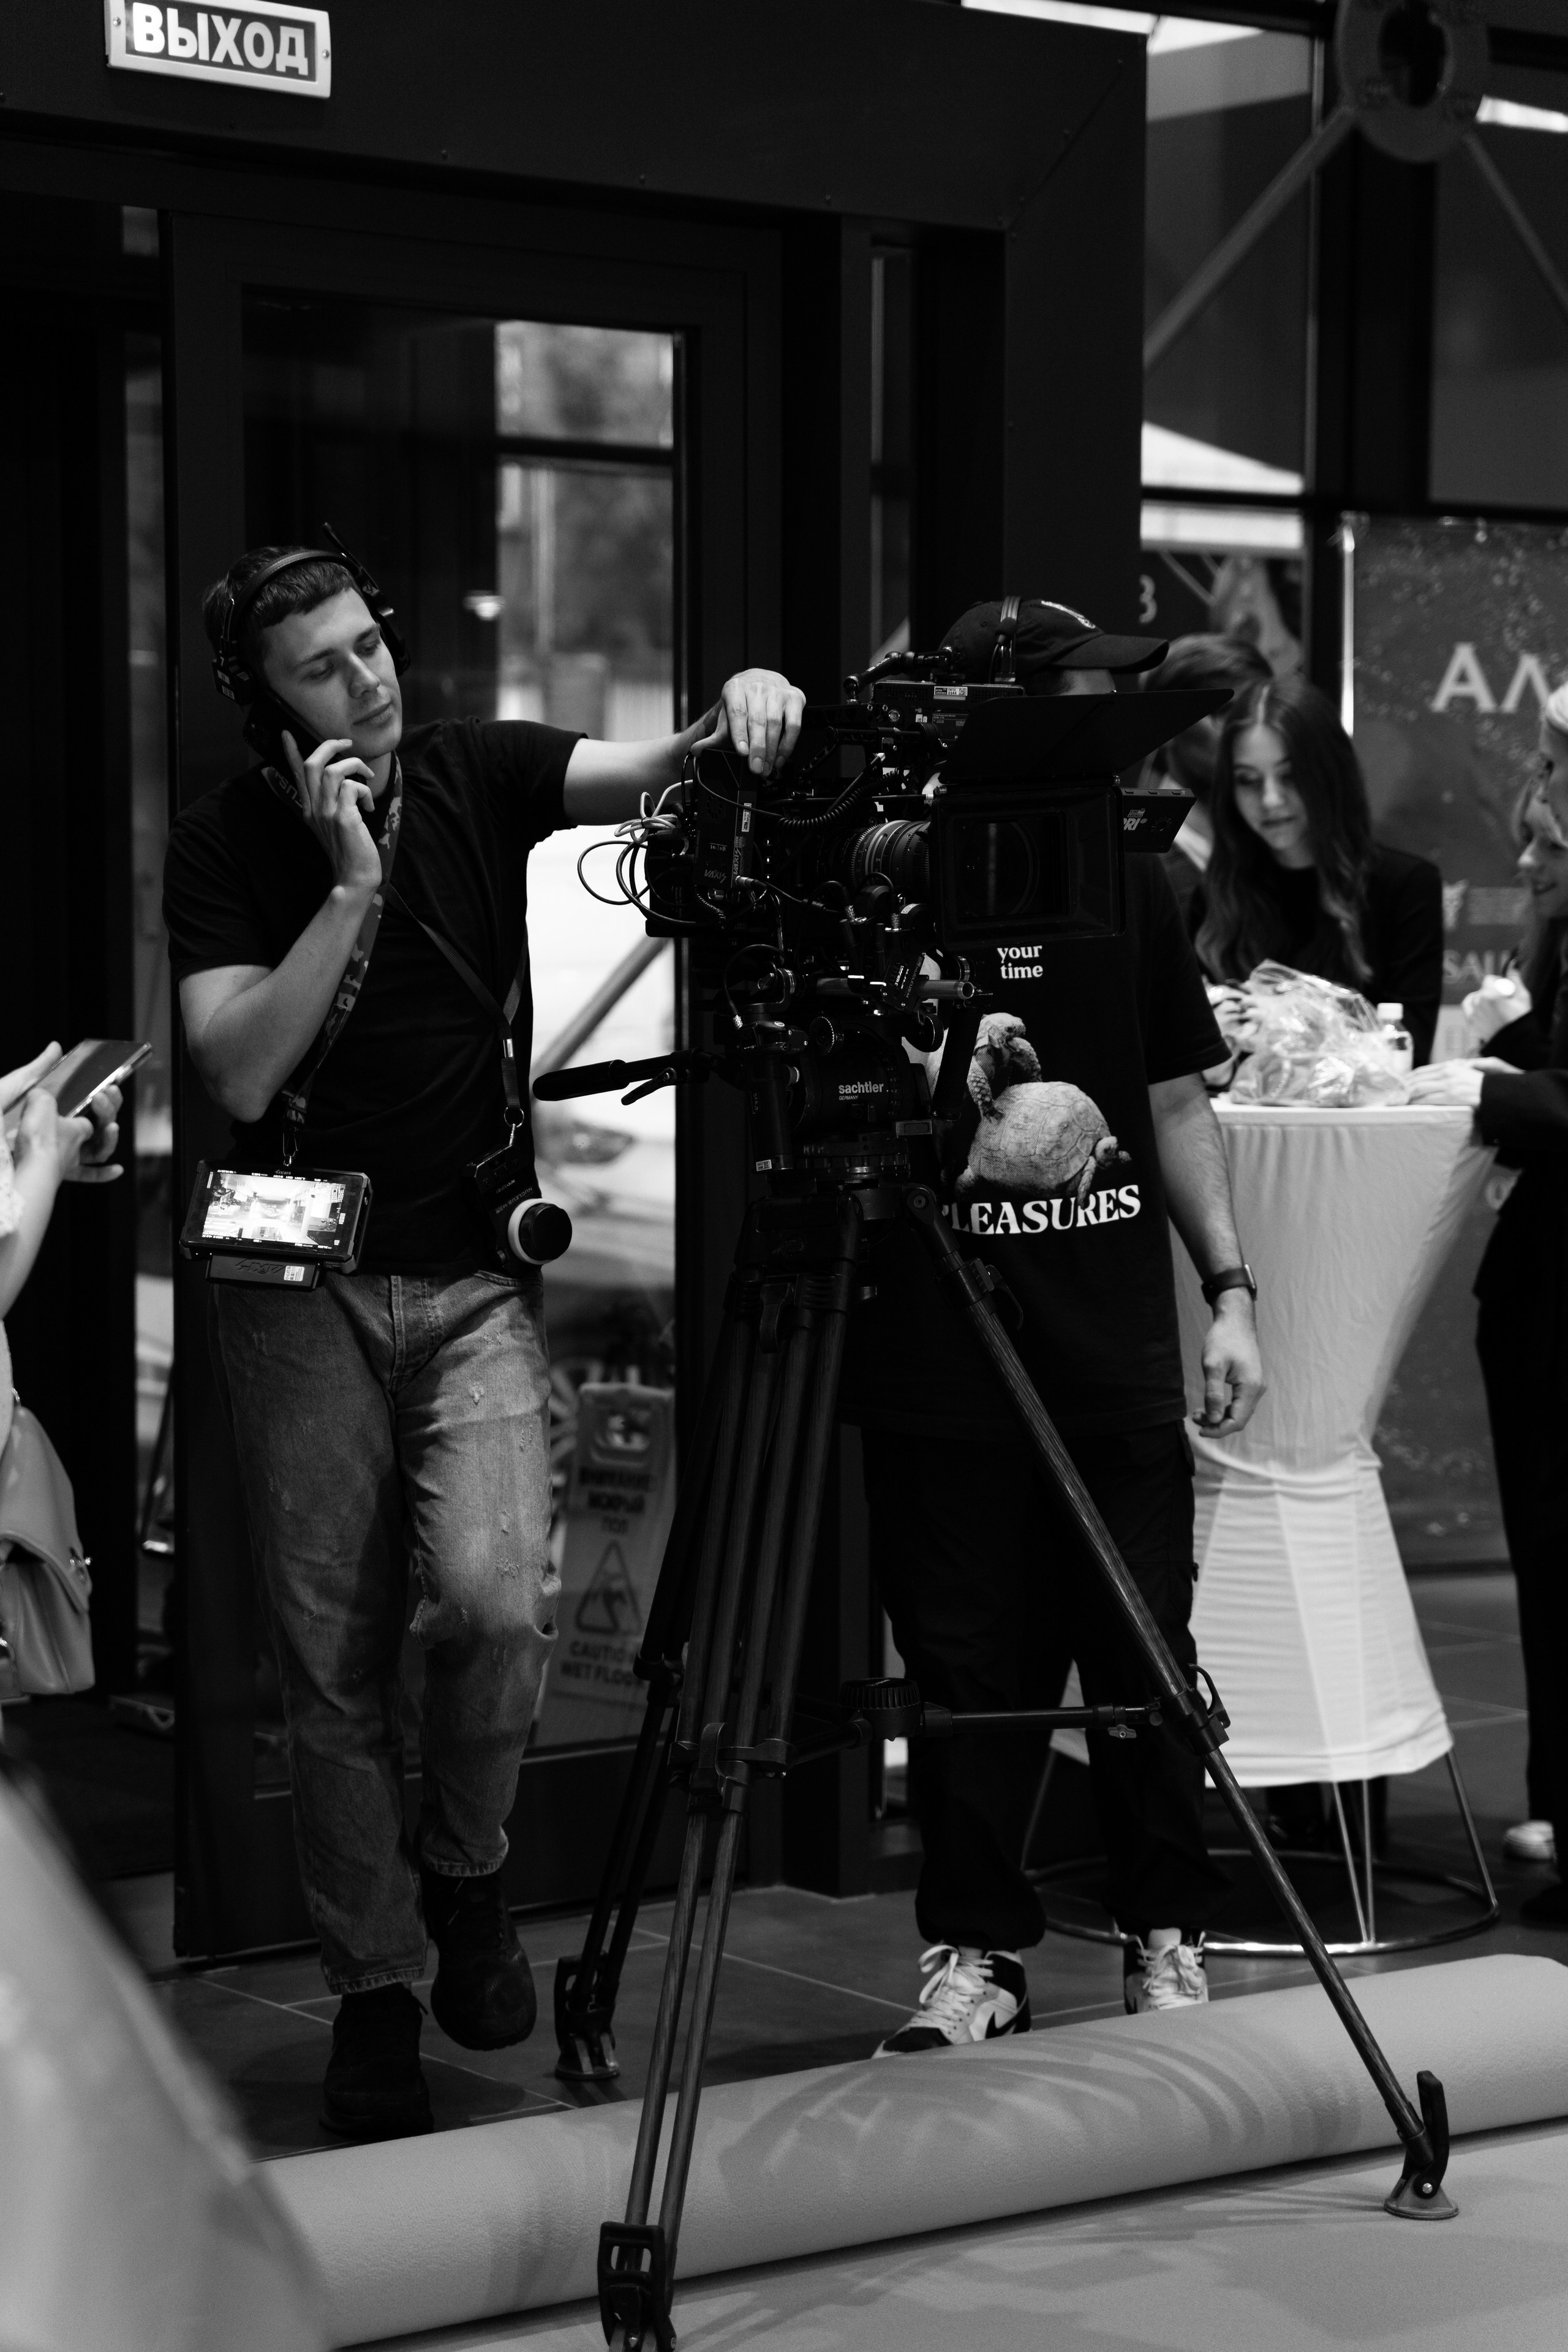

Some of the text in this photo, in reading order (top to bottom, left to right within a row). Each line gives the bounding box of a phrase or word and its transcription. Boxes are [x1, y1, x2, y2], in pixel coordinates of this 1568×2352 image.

[131, 2, 309, 76] ВЫХОД
[733, 848, 743, 875] VAXIS
[704, 869, 727, 883] VAXIS
[997, 945, 1043, 964] your
[1000, 963, 1044, 979] time
[838, 1080, 884, 1094] sachtler
